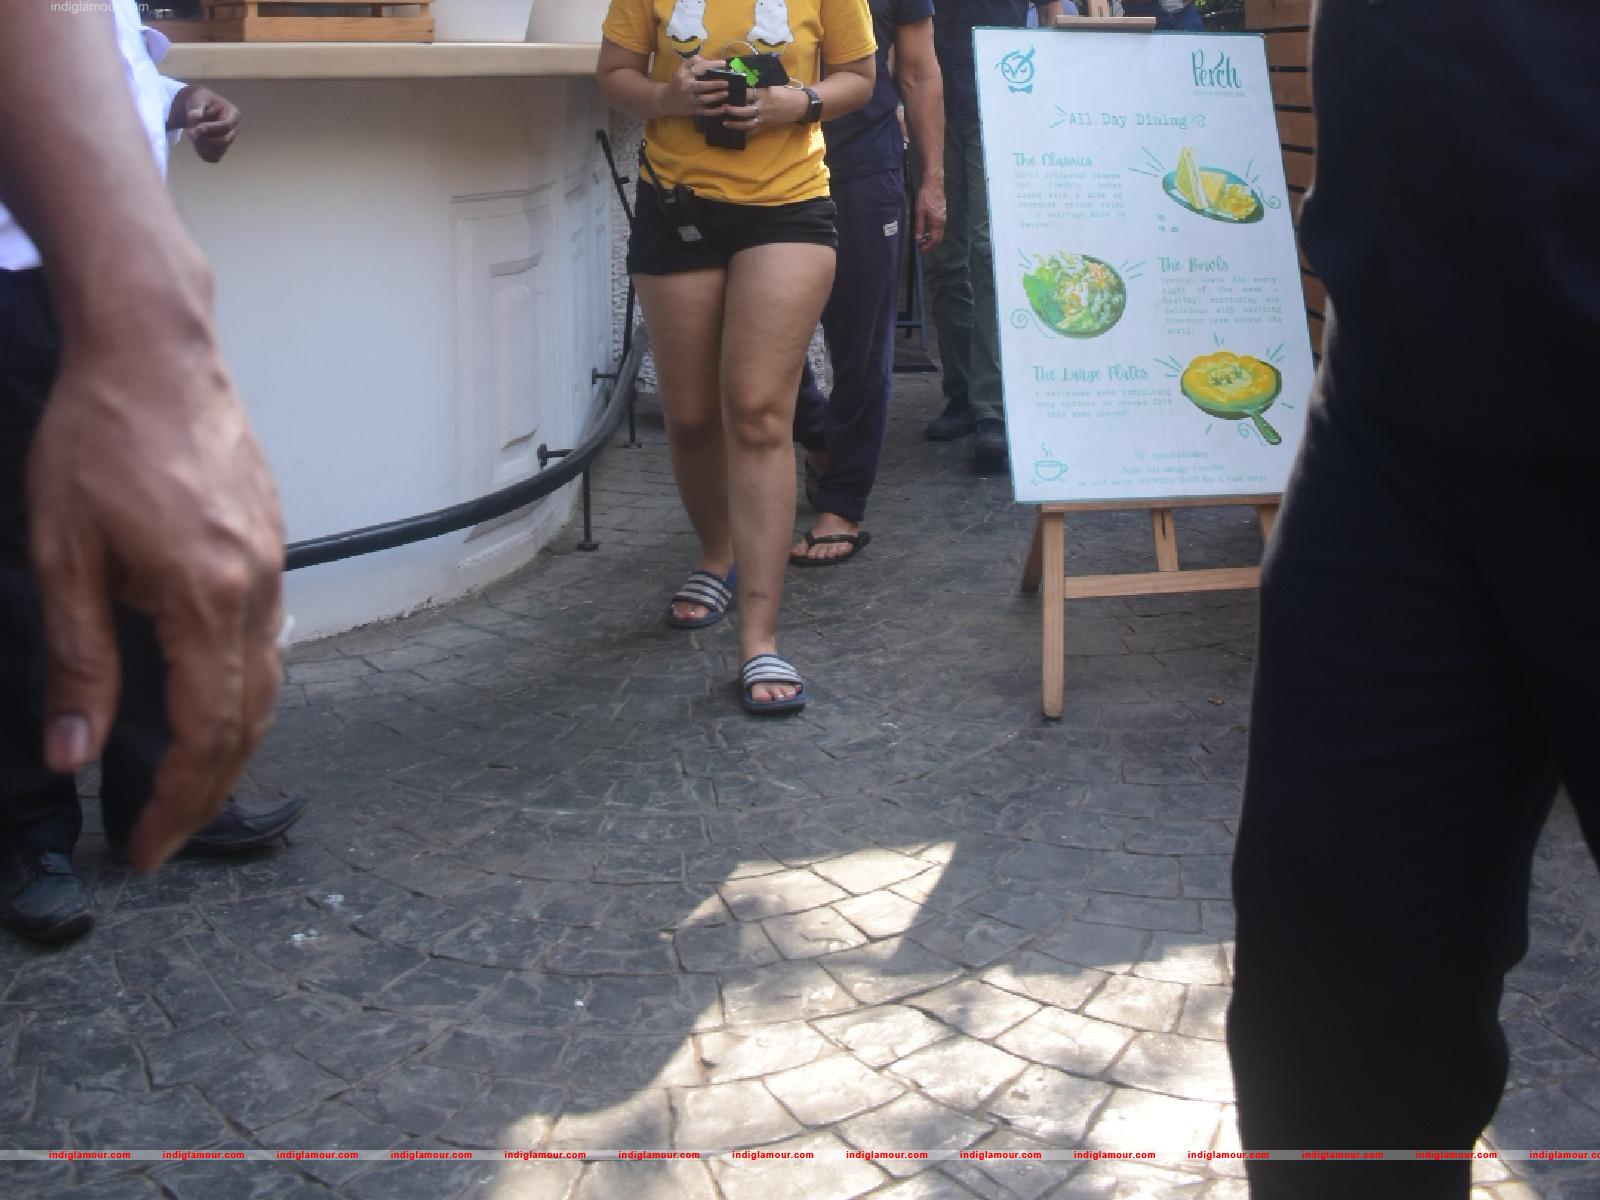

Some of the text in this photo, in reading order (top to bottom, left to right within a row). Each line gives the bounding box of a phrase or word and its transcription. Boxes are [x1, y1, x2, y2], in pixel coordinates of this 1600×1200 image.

[1191, 48, 1242, 89] Perch
[1069, 112, 1188, 130] All Day Dining
[1011, 152, 1036, 168] The
[1157, 254, 1229, 272] The Bowls
[1032, 363, 1149, 384] The Large Plates
